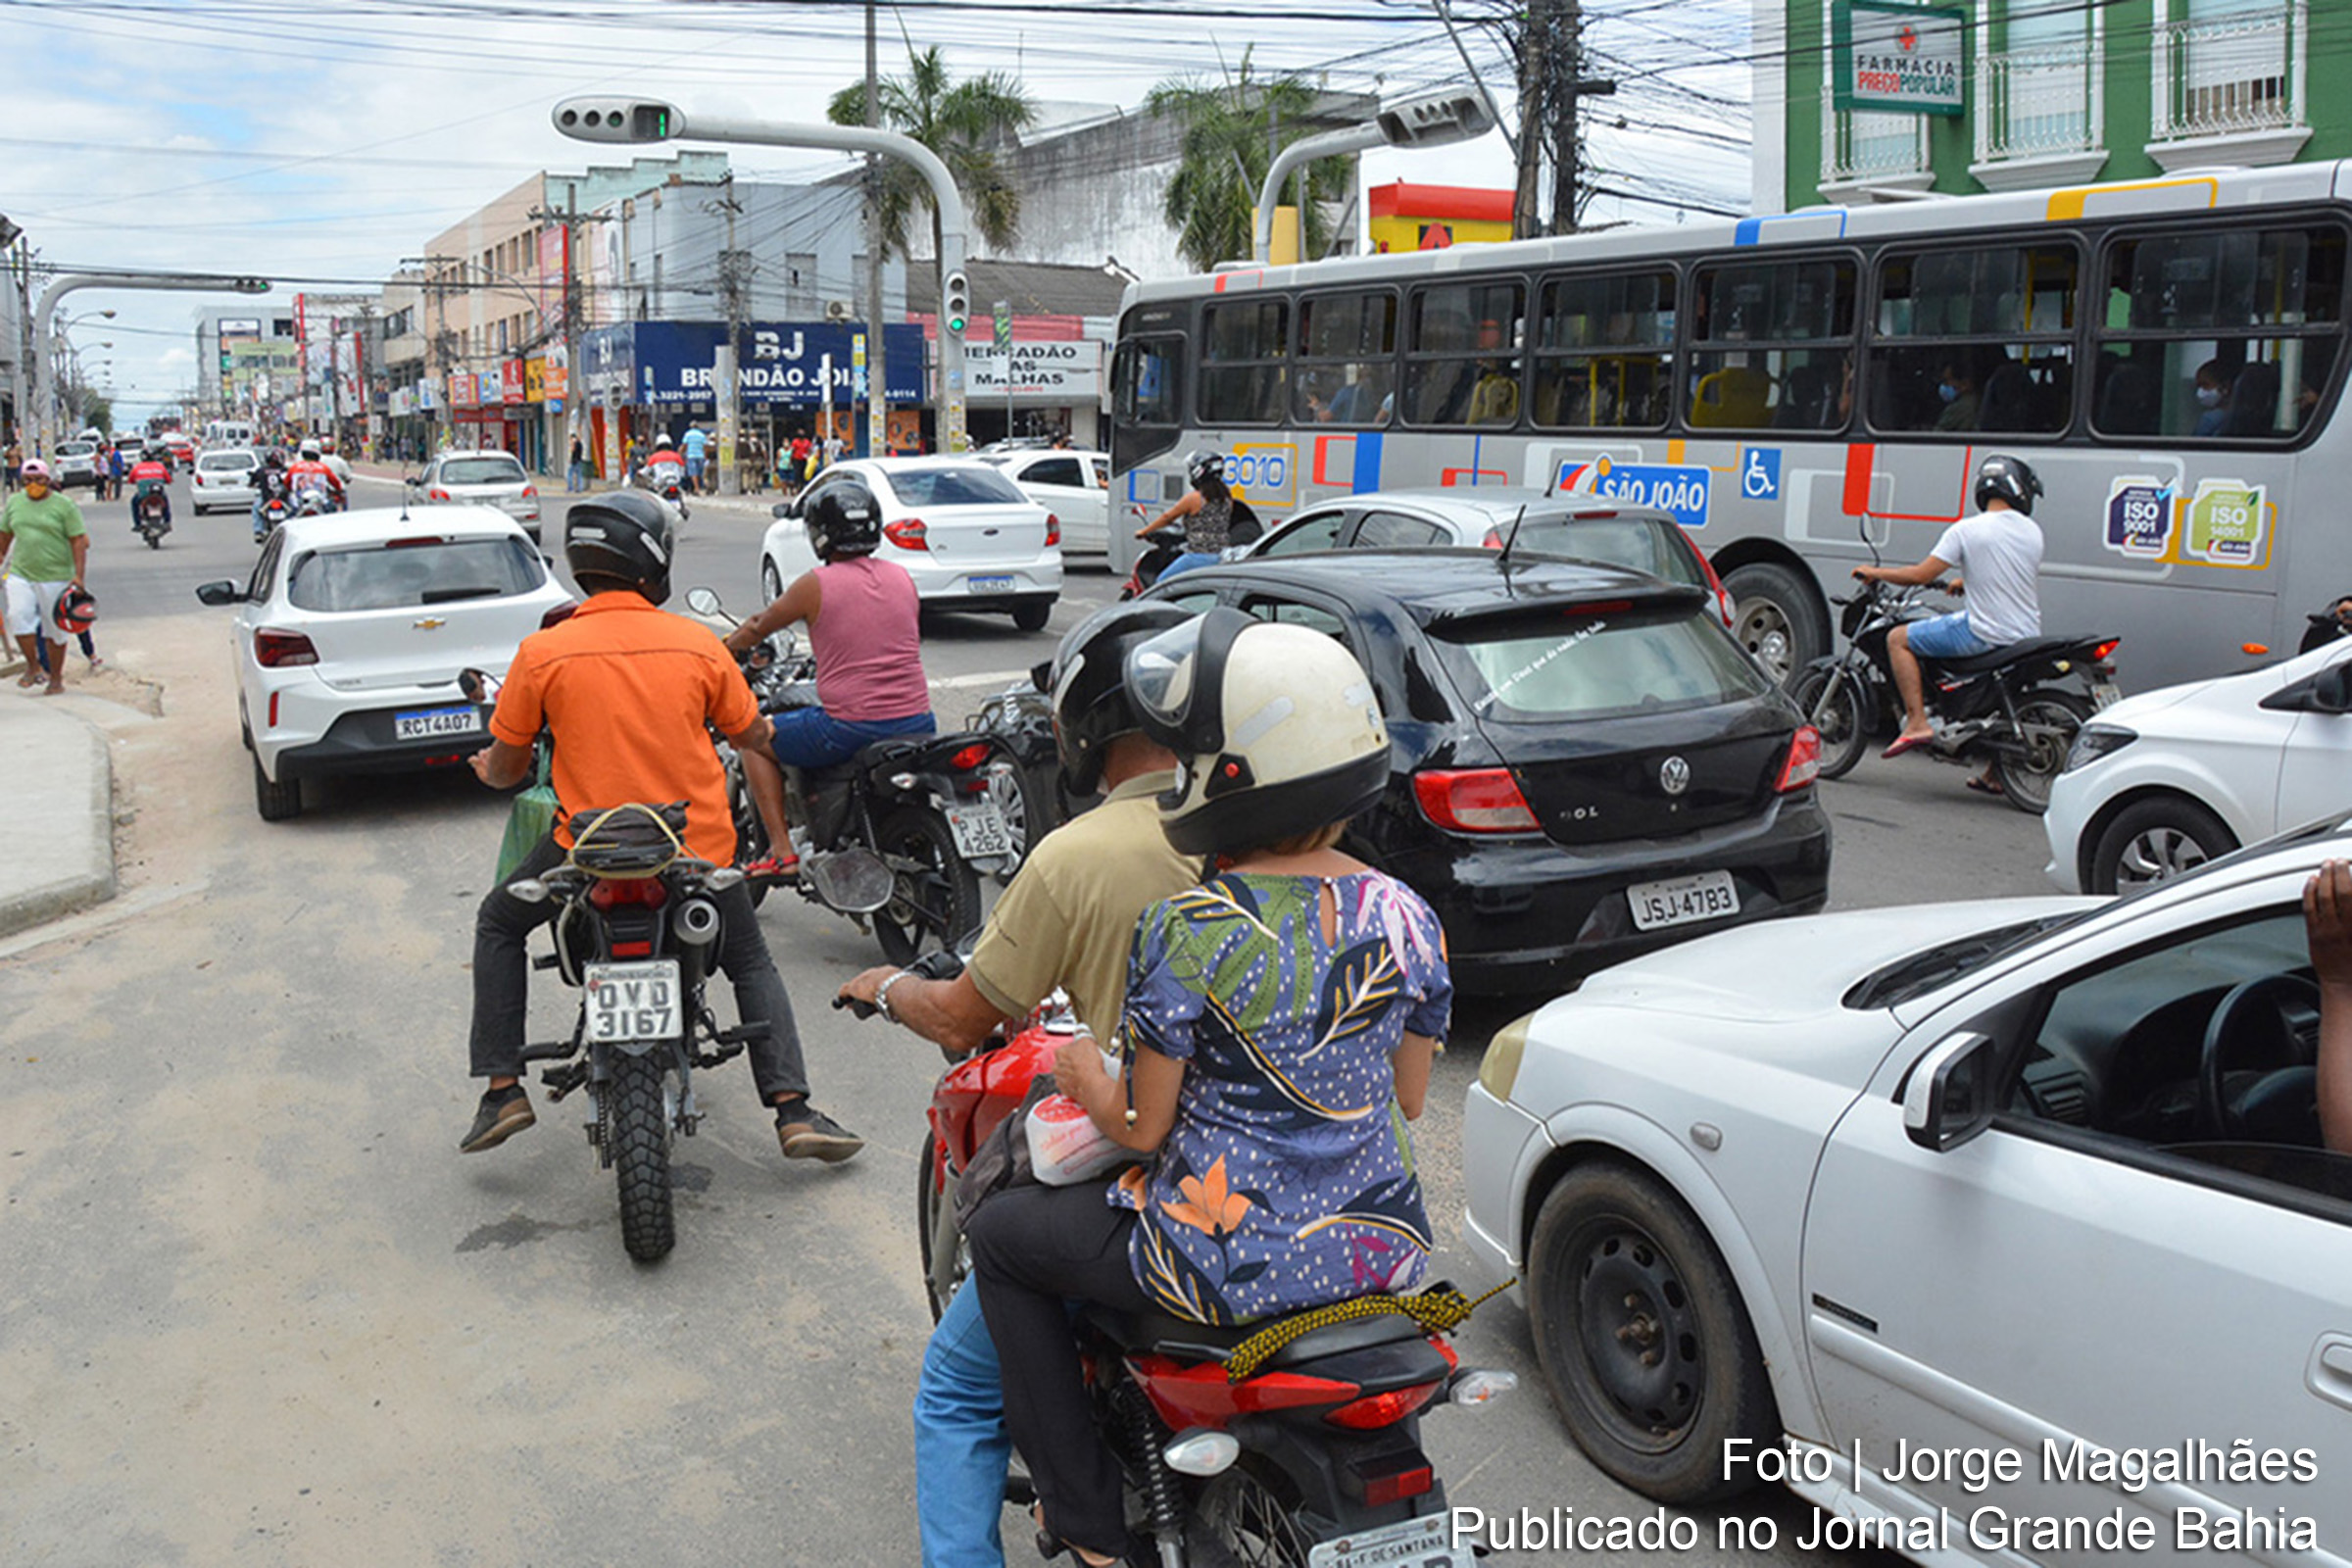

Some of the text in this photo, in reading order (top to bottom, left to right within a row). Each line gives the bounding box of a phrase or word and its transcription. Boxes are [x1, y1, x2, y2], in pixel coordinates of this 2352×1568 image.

[755, 330, 805, 360] BJ
[680, 364, 805, 387] BRNDÃO
[1221, 455, 1286, 488] 3010
[1644, 474, 1705, 512] JOÃO
[2124, 501, 2160, 520] ISO
[2211, 505, 2247, 525] ISO
[403, 713, 472, 736] RCT4A07
[597, 1007, 672, 1037] 3167
